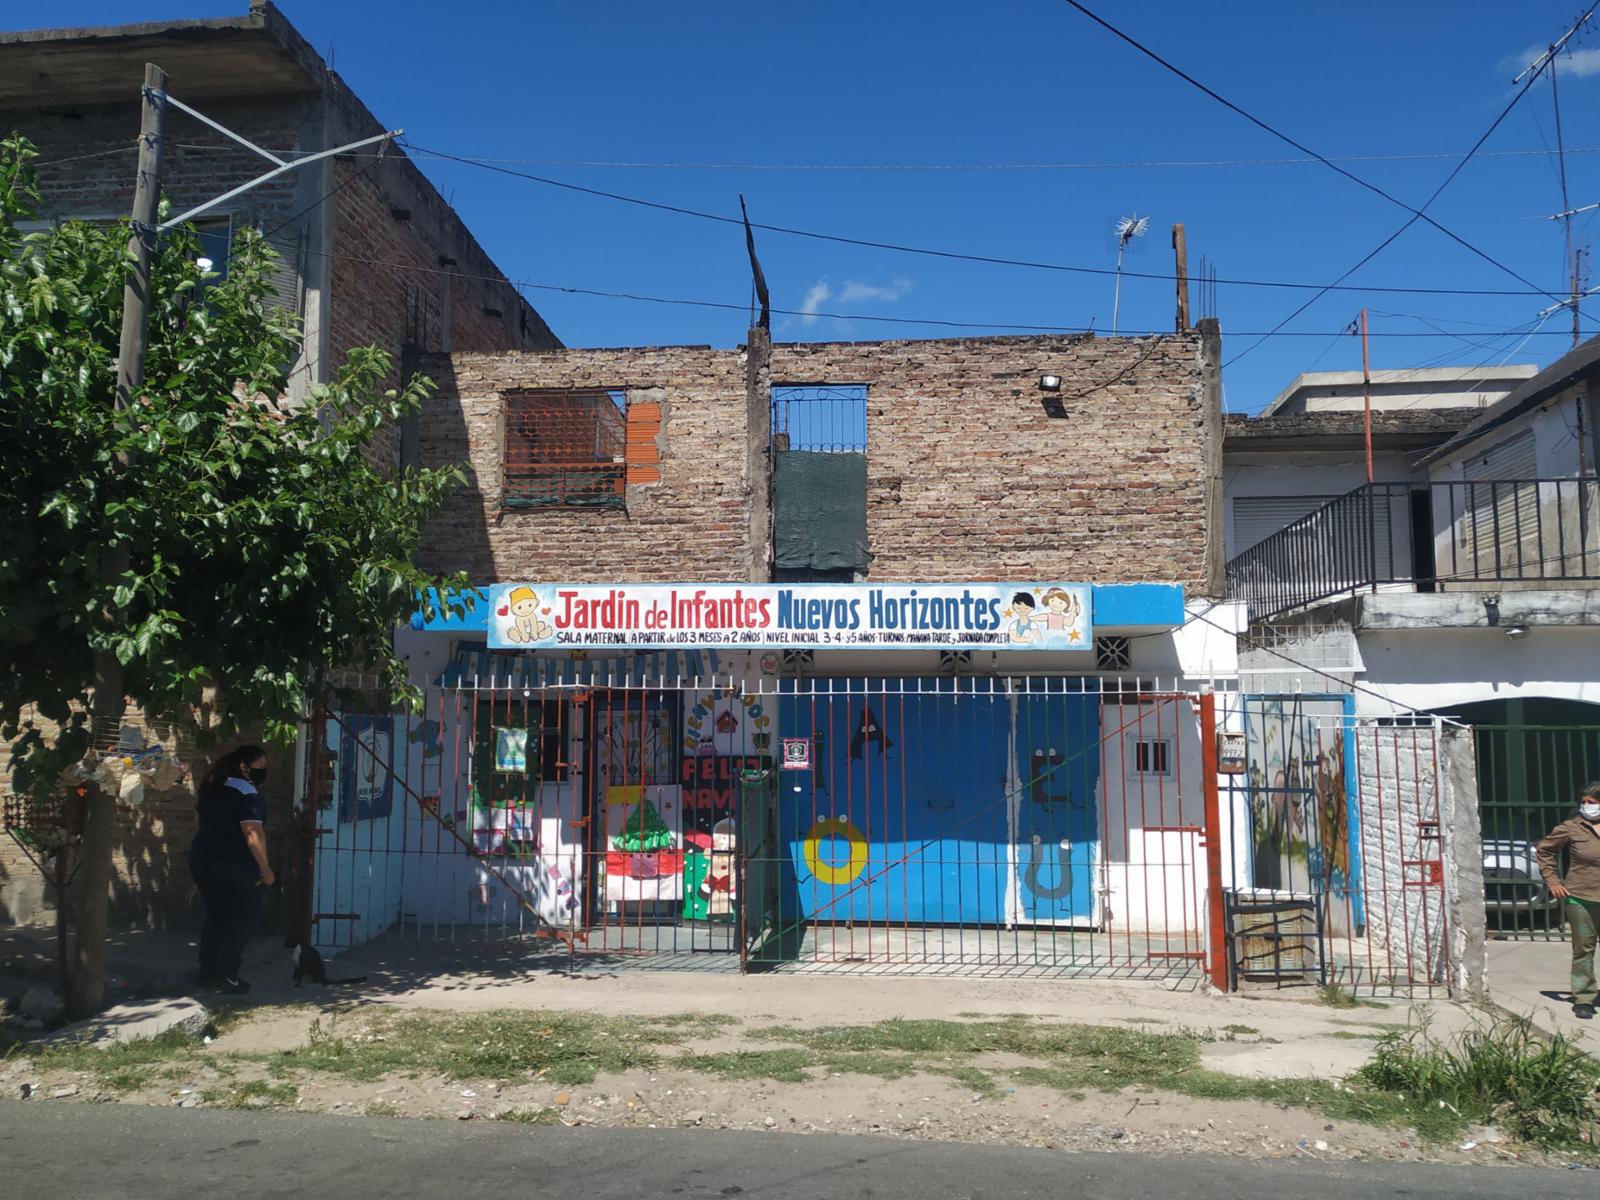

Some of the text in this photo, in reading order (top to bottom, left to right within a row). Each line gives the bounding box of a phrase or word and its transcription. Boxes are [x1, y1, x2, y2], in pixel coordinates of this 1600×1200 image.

[555, 588, 1001, 630] Jardin de Infantes Nuevos Horizontes
[556, 631, 582, 644] SALA
[584, 632, 628, 645] MATERNAL
[638, 632, 666, 643] PARTIR
[676, 631, 688, 643] LOS
[690, 631, 697, 643] 3
[698, 631, 722, 643] MESES
[730, 631, 738, 643] 2
[766, 631, 789, 643] NIVEL
[791, 631, 820, 643] INICIAL
